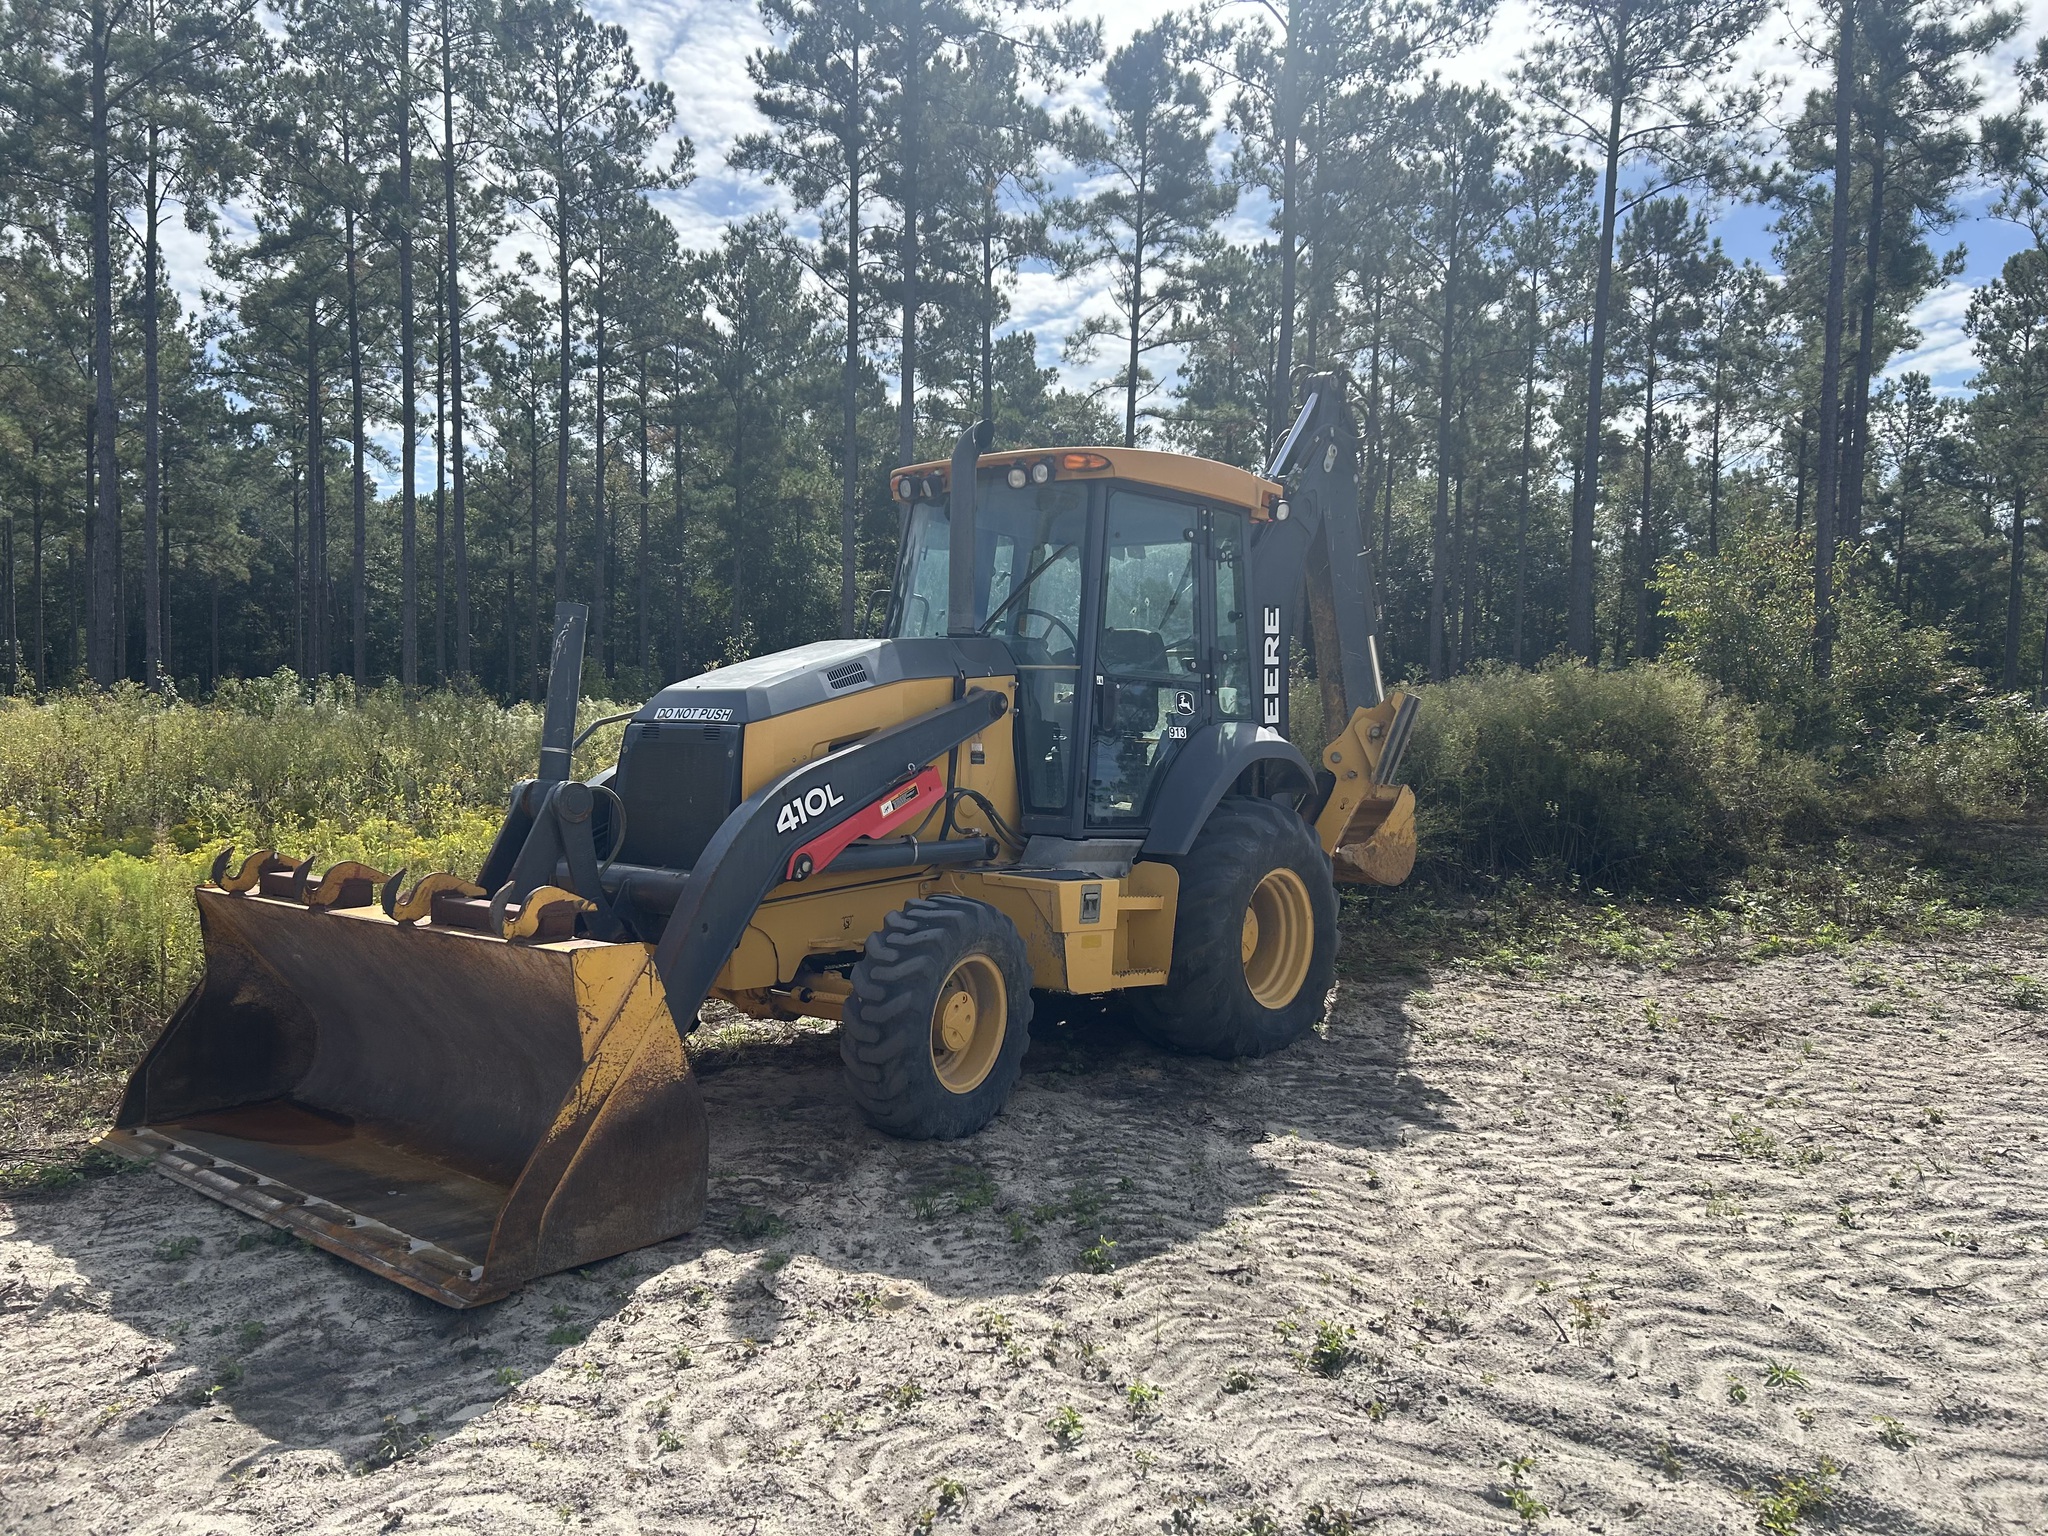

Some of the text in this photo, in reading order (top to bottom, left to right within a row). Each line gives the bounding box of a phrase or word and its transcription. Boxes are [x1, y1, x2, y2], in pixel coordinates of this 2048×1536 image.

[1263, 607, 1280, 735] EERE
[657, 708, 732, 720] DO NOT PUSH
[1170, 727, 1186, 738] 913
[776, 784, 844, 834] 410L
